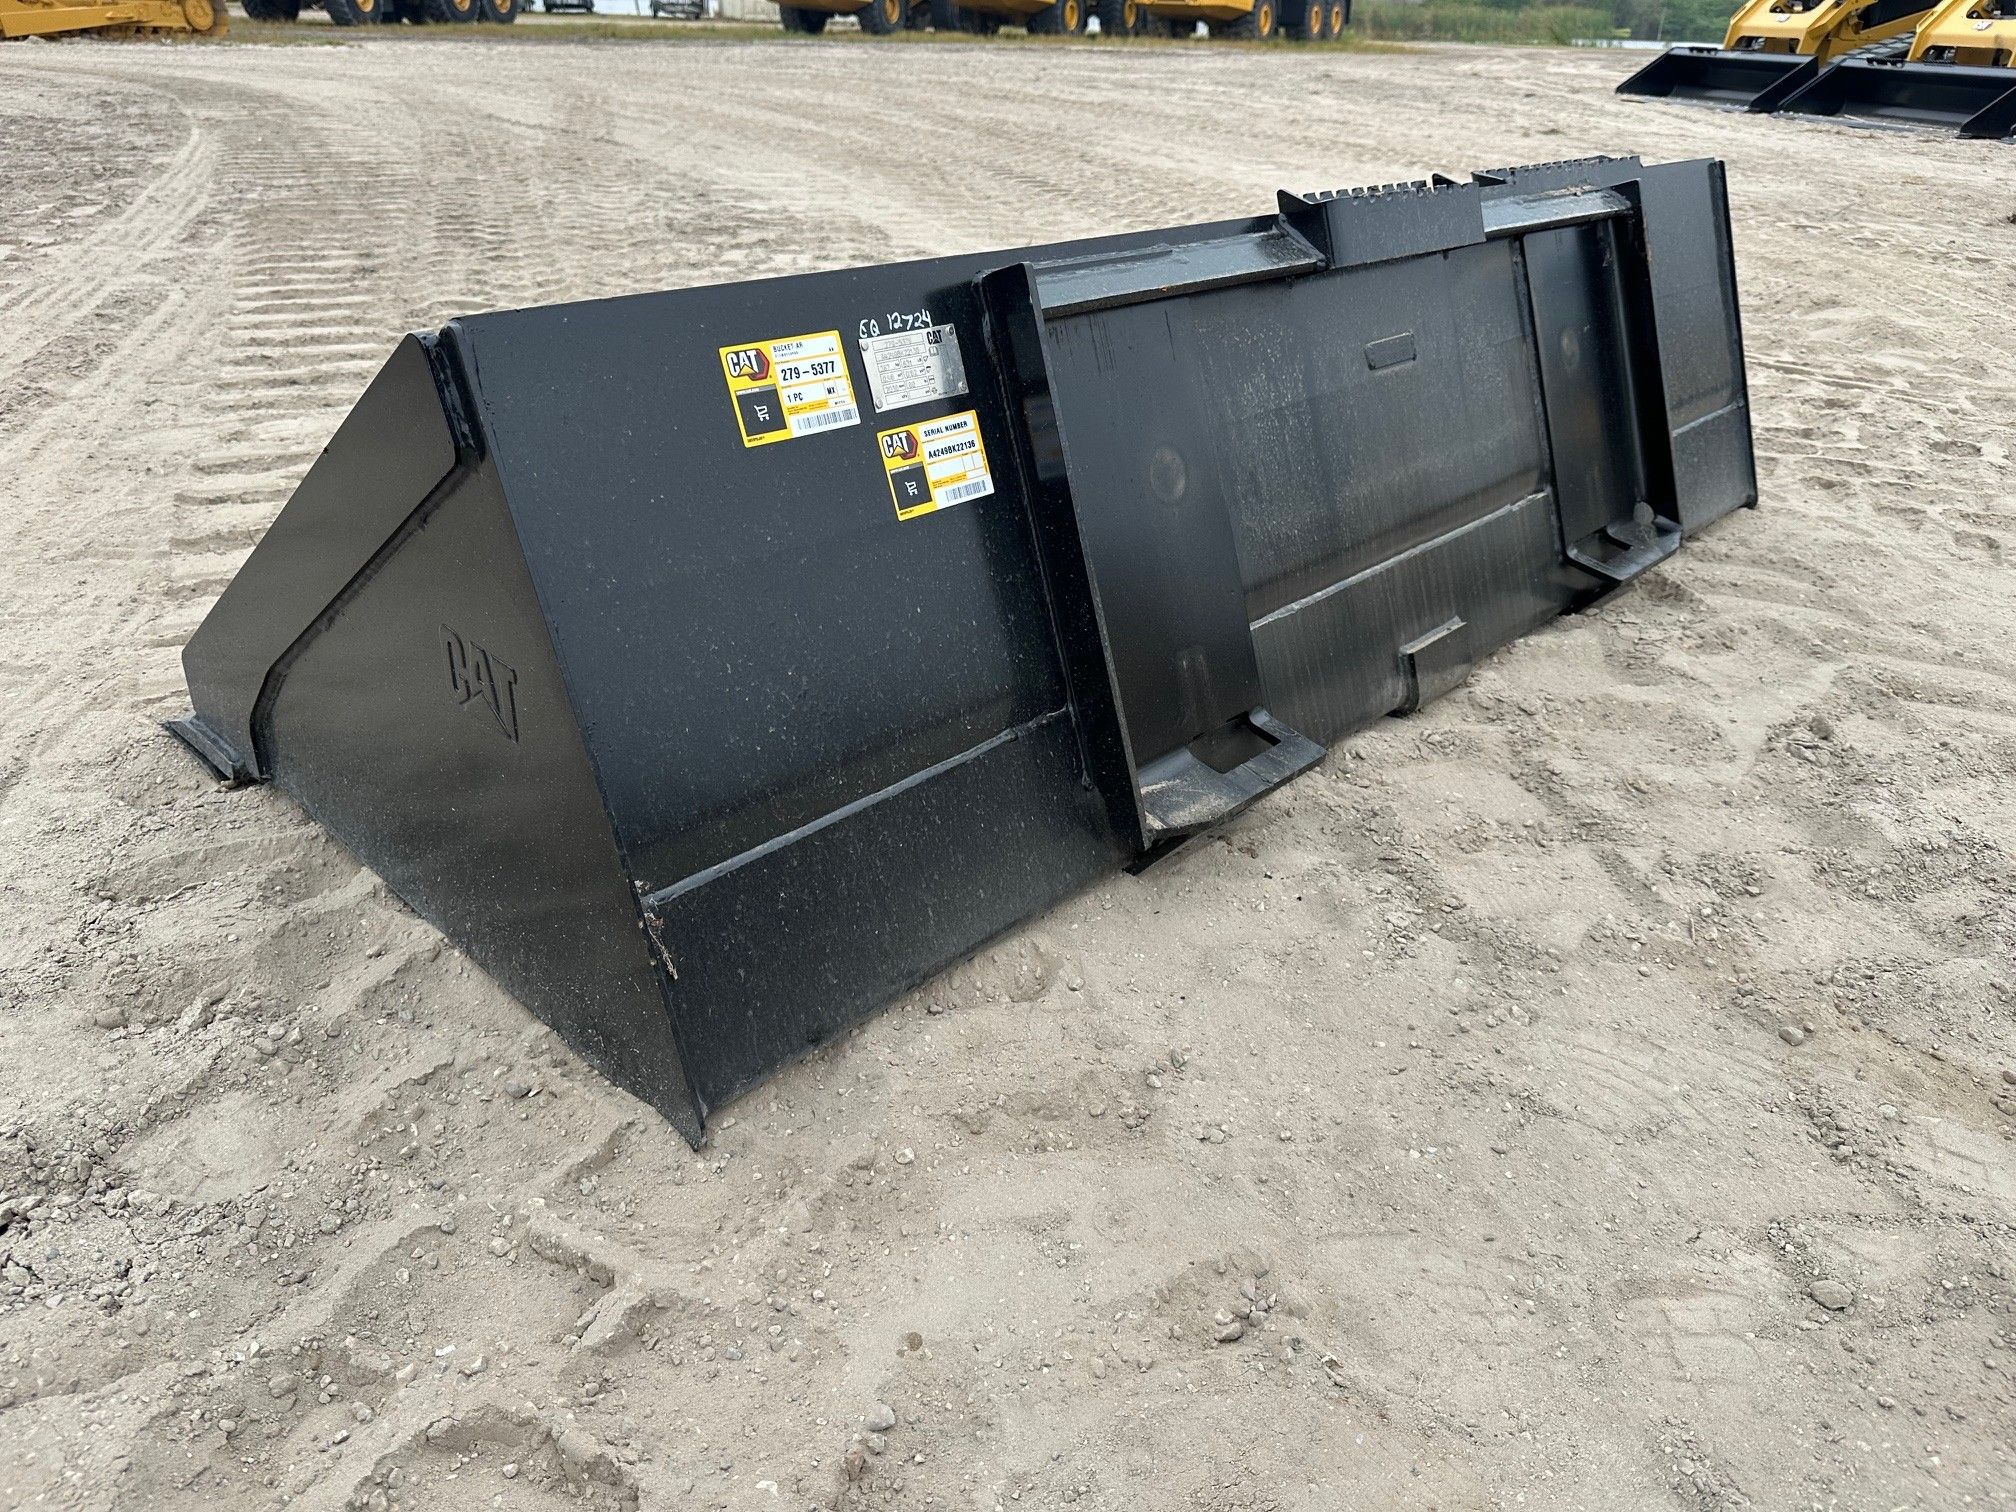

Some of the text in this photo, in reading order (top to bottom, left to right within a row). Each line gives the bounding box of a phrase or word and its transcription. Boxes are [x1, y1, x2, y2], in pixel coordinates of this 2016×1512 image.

[859, 309, 933, 338] EQ 12724
[926, 330, 942, 345] CAT
[772, 343, 794, 353] BUCKET
[726, 350, 760, 377] CAT
[787, 393, 803, 403] 1 PC
[826, 387, 836, 395] MX
[923, 420, 968, 438] SERIAL NUMBER
[883, 432, 910, 458] CAT
[928, 439, 976, 459] A4249BK22136
[439, 623, 518, 744] CAT
